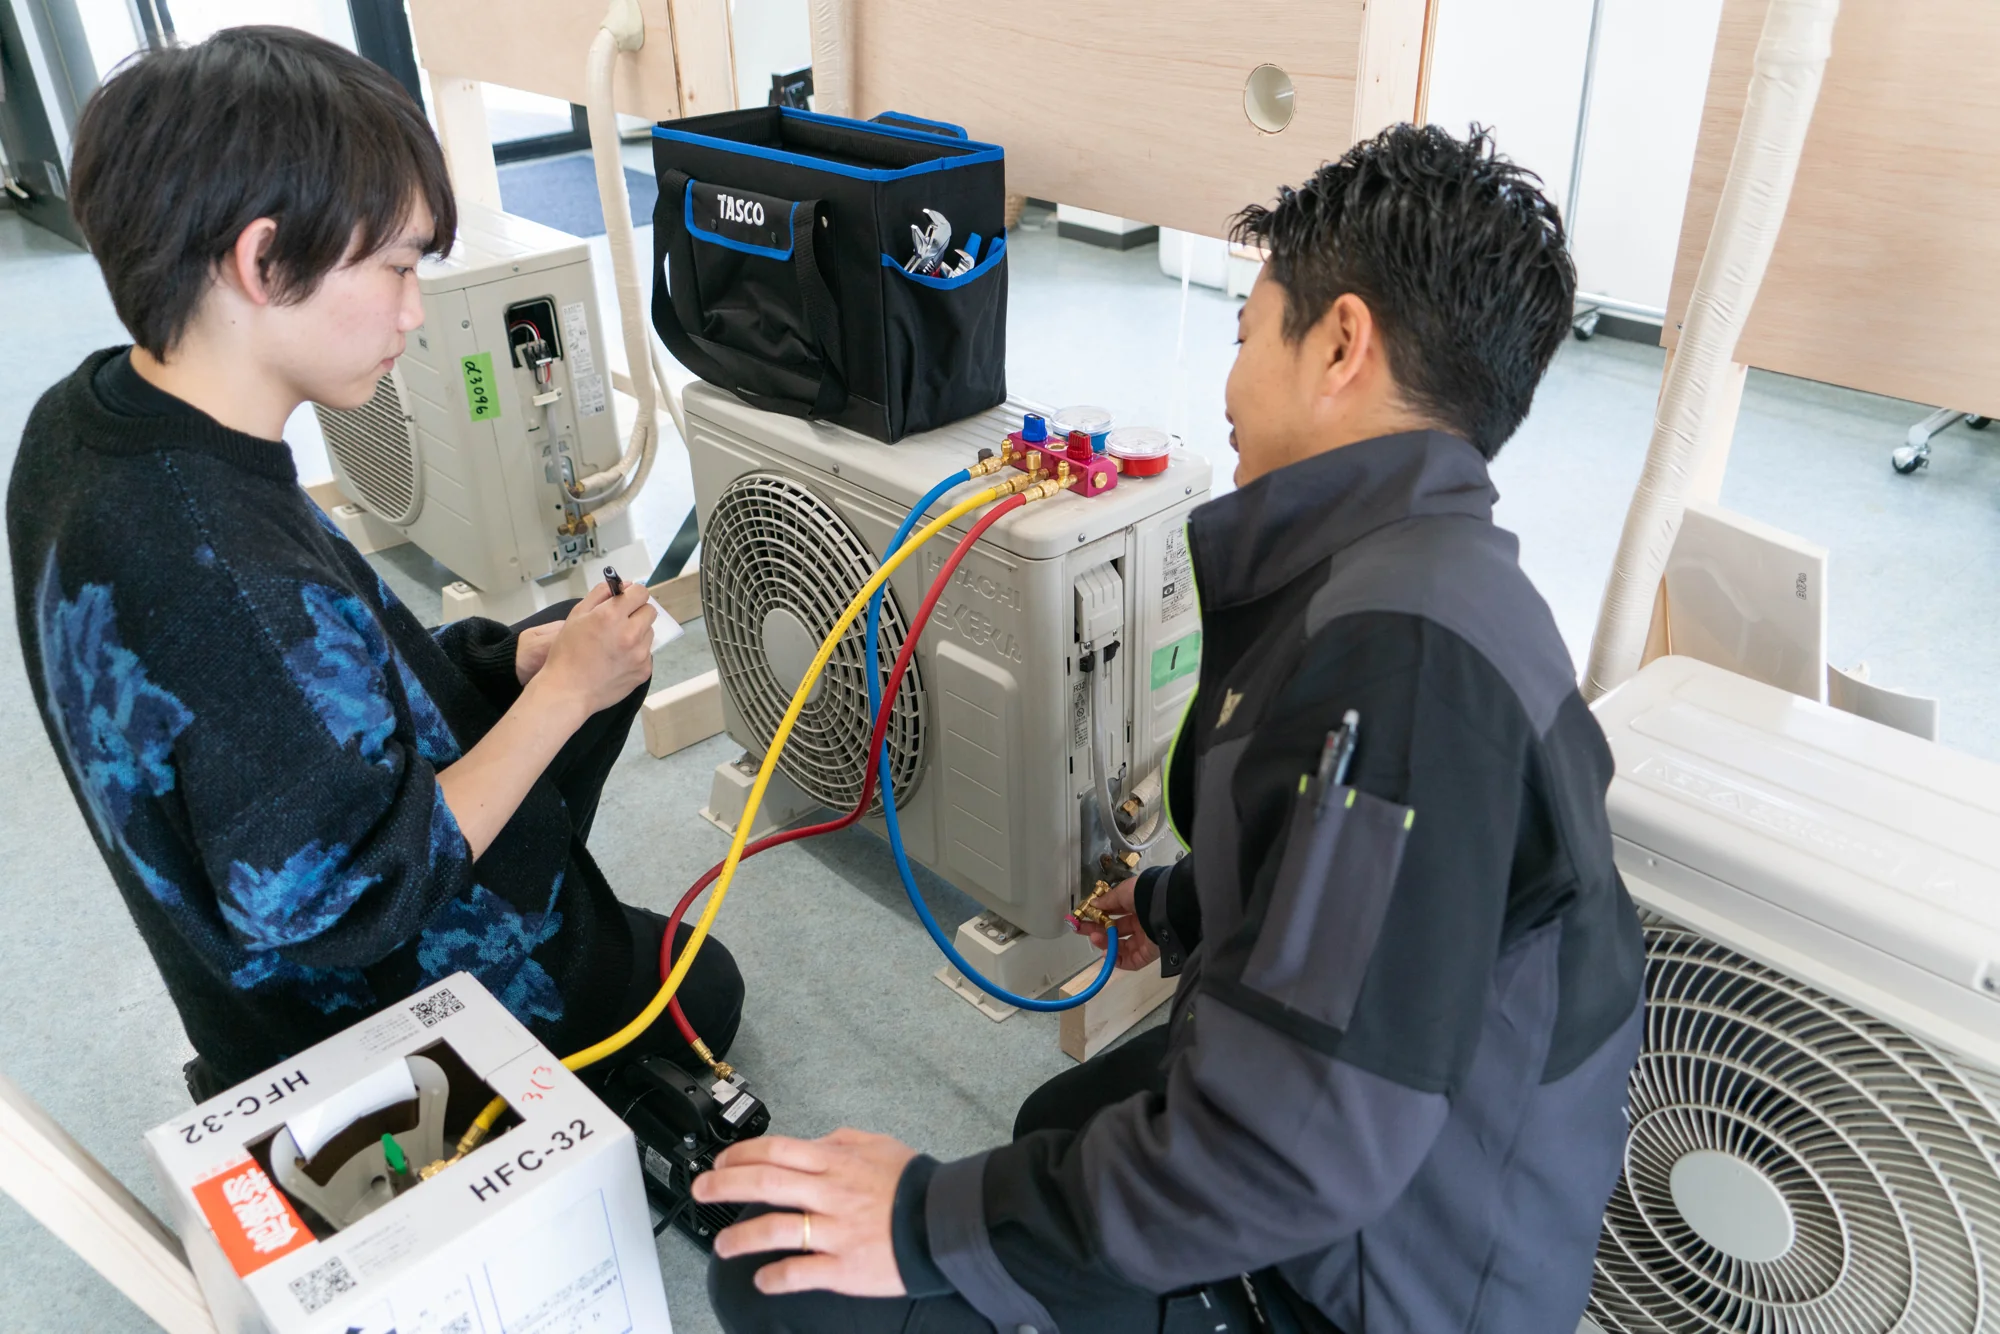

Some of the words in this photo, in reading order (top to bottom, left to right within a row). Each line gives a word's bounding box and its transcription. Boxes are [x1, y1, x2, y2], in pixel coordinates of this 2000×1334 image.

[717, 193, 765, 227] TASCO
[1073, 681, 1086, 693] R32
[180, 1069, 311, 1145] HFC-32
[469, 1117, 595, 1203] HFC-32
